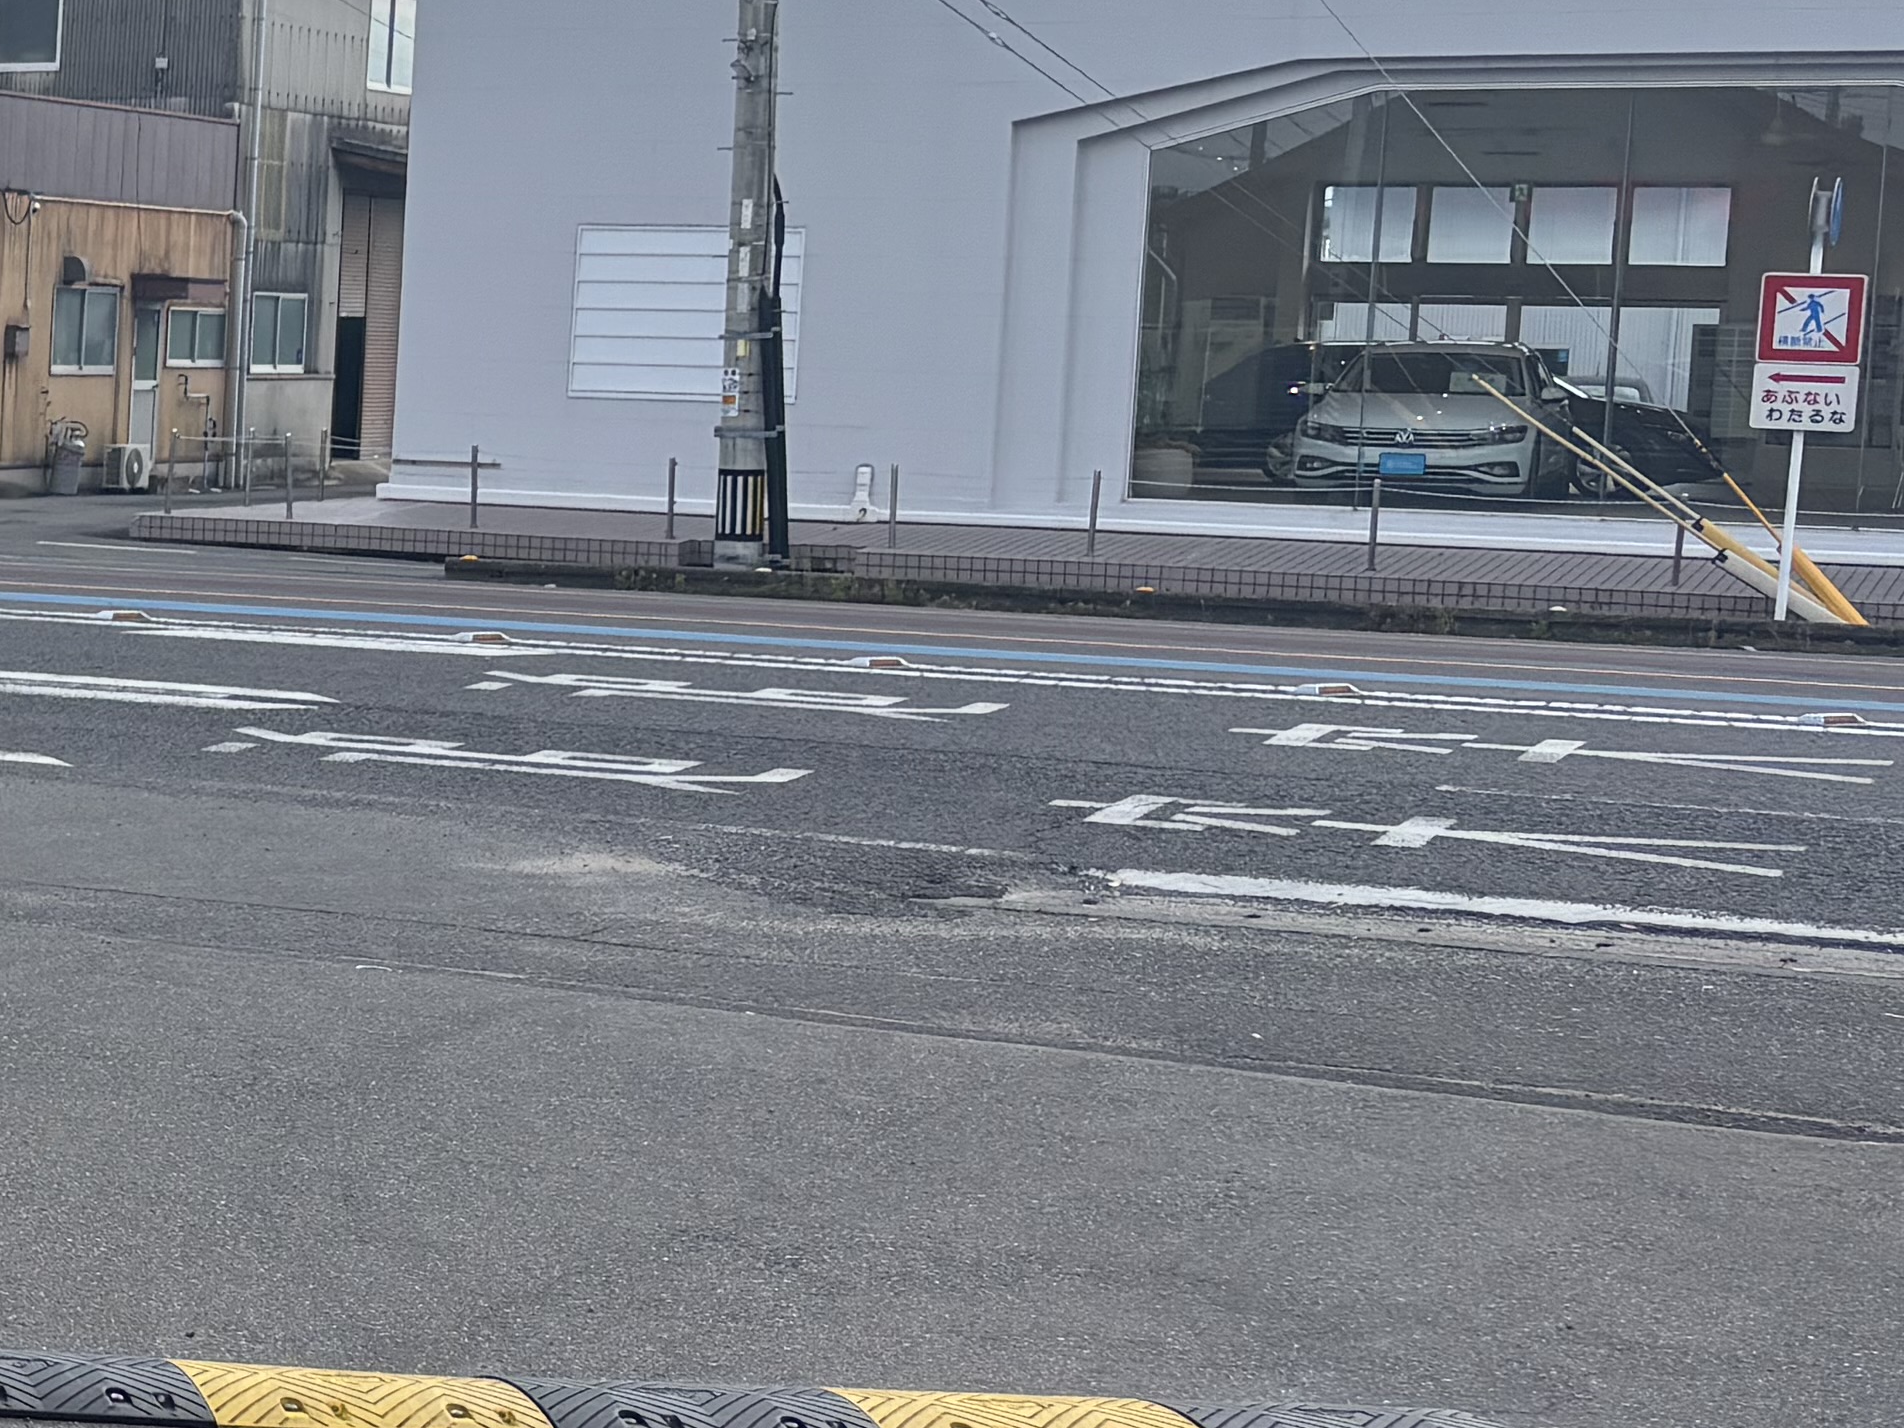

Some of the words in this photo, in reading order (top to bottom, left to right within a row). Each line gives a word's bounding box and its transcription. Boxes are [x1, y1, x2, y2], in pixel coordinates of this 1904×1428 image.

[1778, 335, 1825, 349] 横断禁止
[1761, 388, 1841, 407] あぶない
[1765, 407, 1847, 425] わたるな
